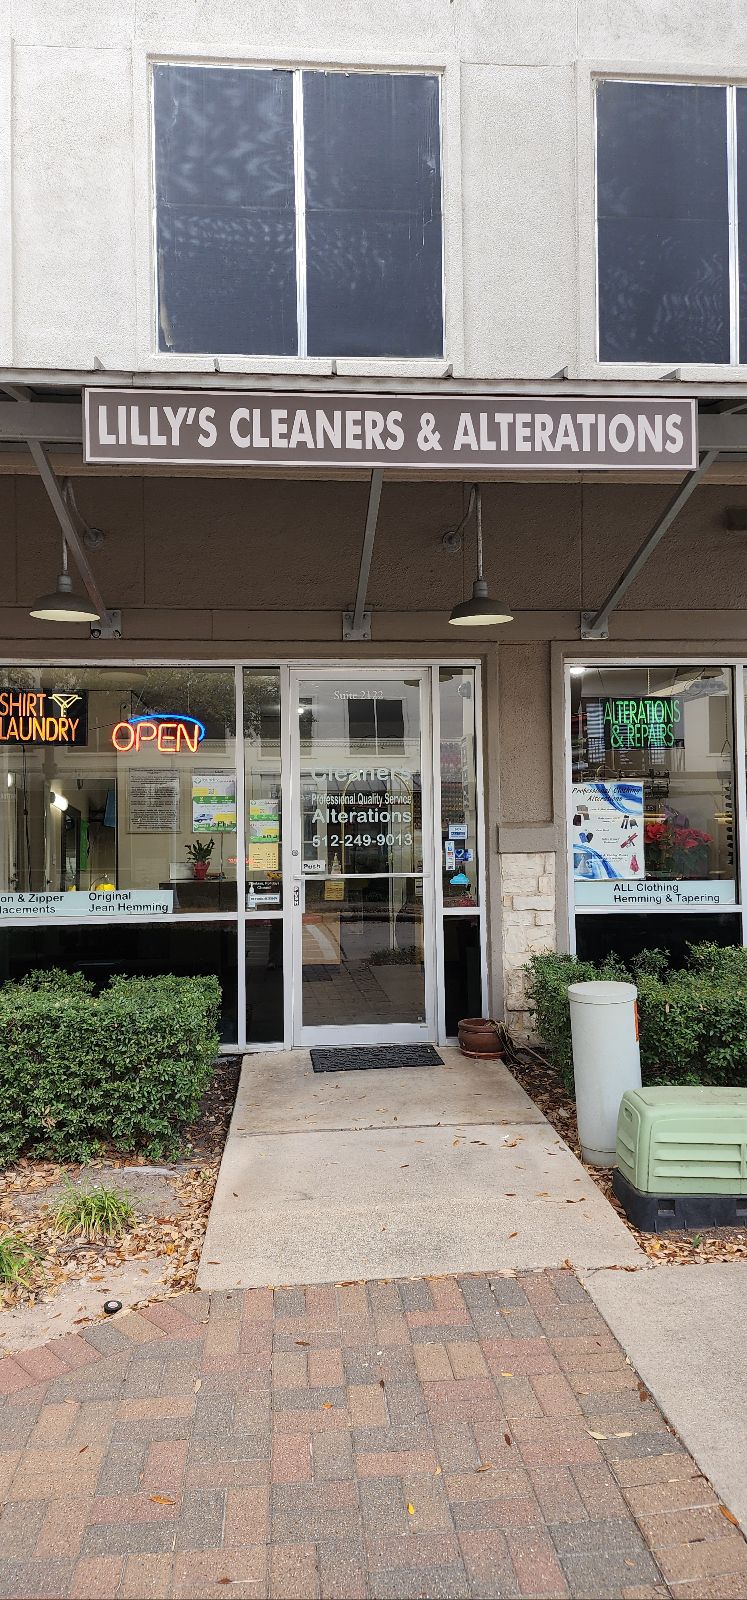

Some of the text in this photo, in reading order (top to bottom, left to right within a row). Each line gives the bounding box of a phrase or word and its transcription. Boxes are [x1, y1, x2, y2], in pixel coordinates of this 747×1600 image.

[98, 405, 684, 453] LILLY'S CLEANERS & ALTERATIONS
[333, 690, 357, 700] Suite
[0, 692, 46, 717] SHIRT
[603, 700, 681, 724] ALTERATIONS
[0, 716, 80, 742] LAUNDRY
[610, 723, 675, 748] & REPAIRS
[111, 722, 200, 752] OPEN
[311, 766, 411, 781] Cleaners
[311, 792, 412, 808] Professional Quality Service
[311, 808, 412, 824] Alterations
[311, 833, 413, 847] 512-249-9013
[613, 883, 680, 894] ALL Clothing
[17, 893, 26, 903] &
[28, 893, 65, 905] Zipper
[88, 892, 132, 902] Original
[614, 893, 720, 905] Hemming & Tapering
[88, 902, 169, 914] Jean Hemming
